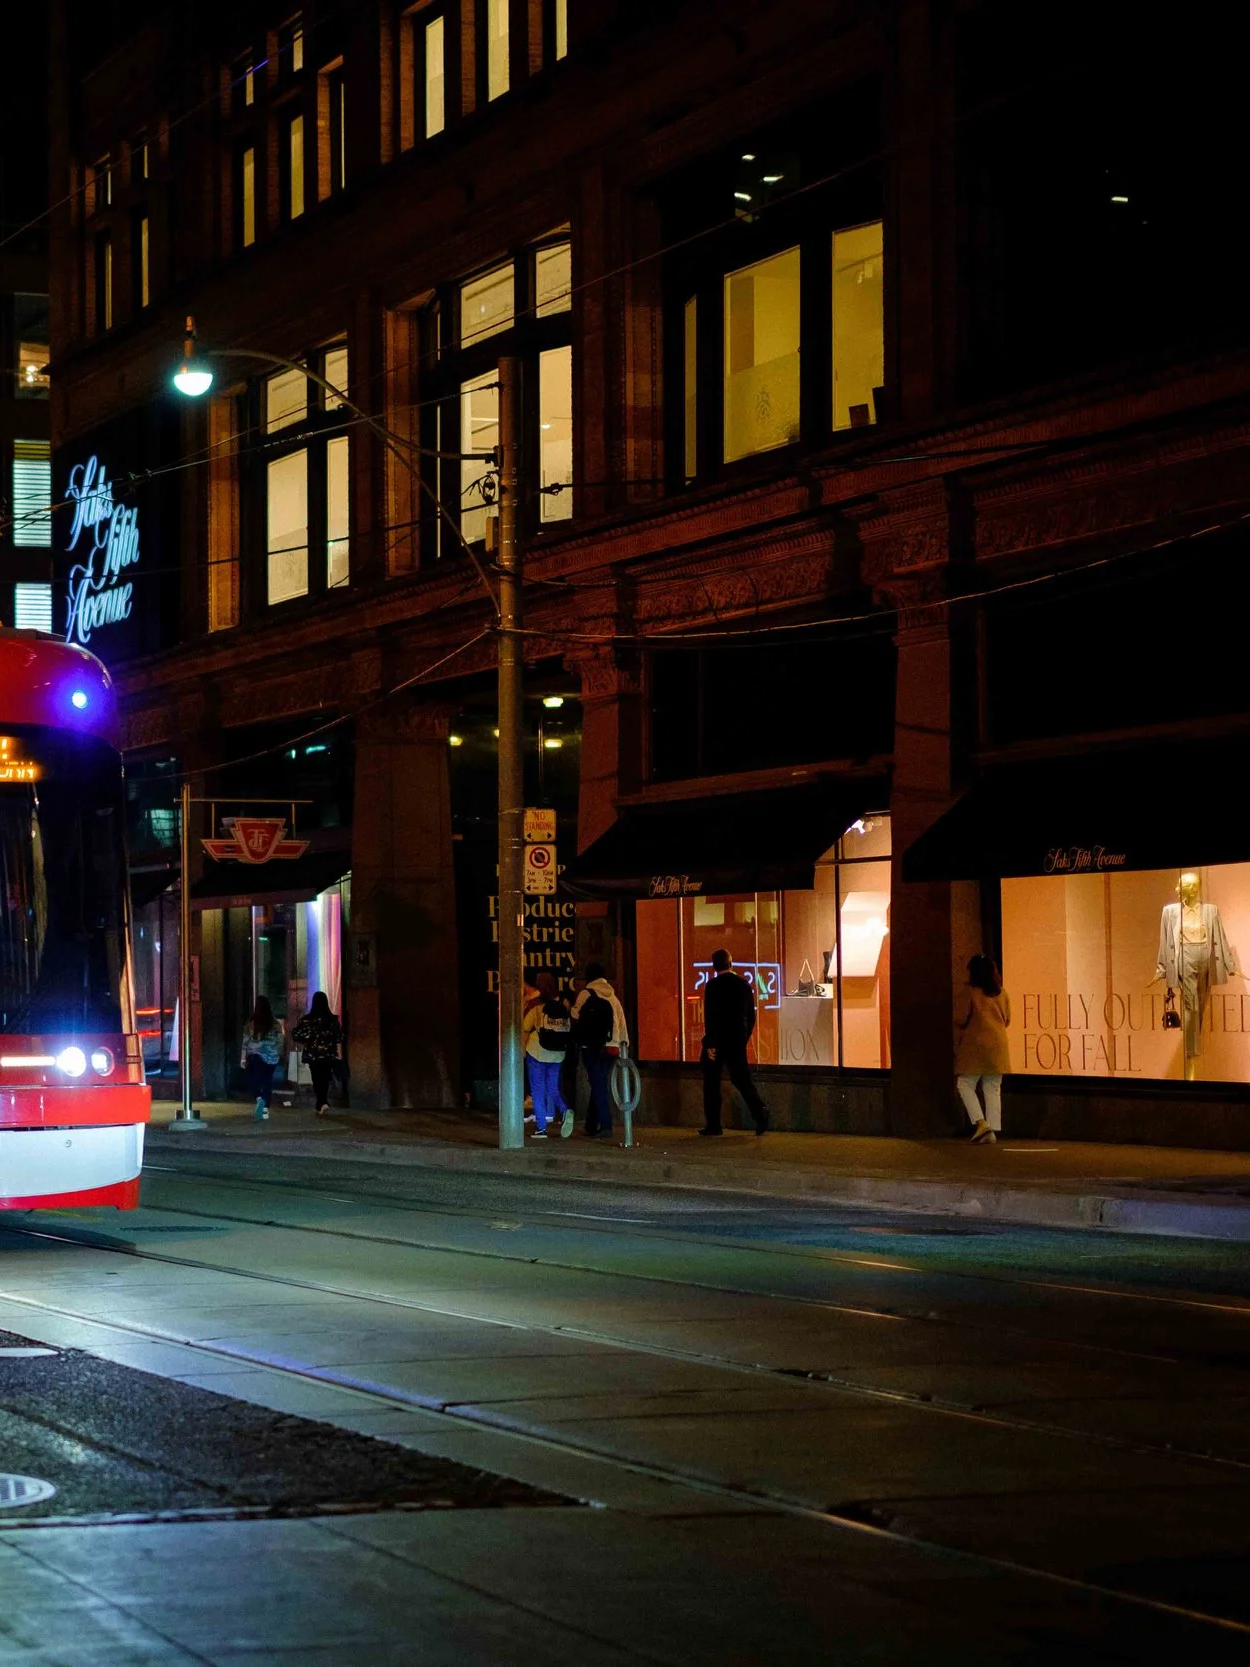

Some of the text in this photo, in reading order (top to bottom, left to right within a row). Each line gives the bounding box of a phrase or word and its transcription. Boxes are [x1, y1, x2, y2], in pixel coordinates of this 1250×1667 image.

[65, 455, 114, 551] Saks
[90, 503, 140, 590] Fifth
[65, 564, 133, 643] Avenue
[525, 821, 554, 832] STANDING
[533, 811, 546, 820] NO
[1022, 993, 1095, 1030] FULLY
[1023, 1032, 1142, 1072] FOR FALL
